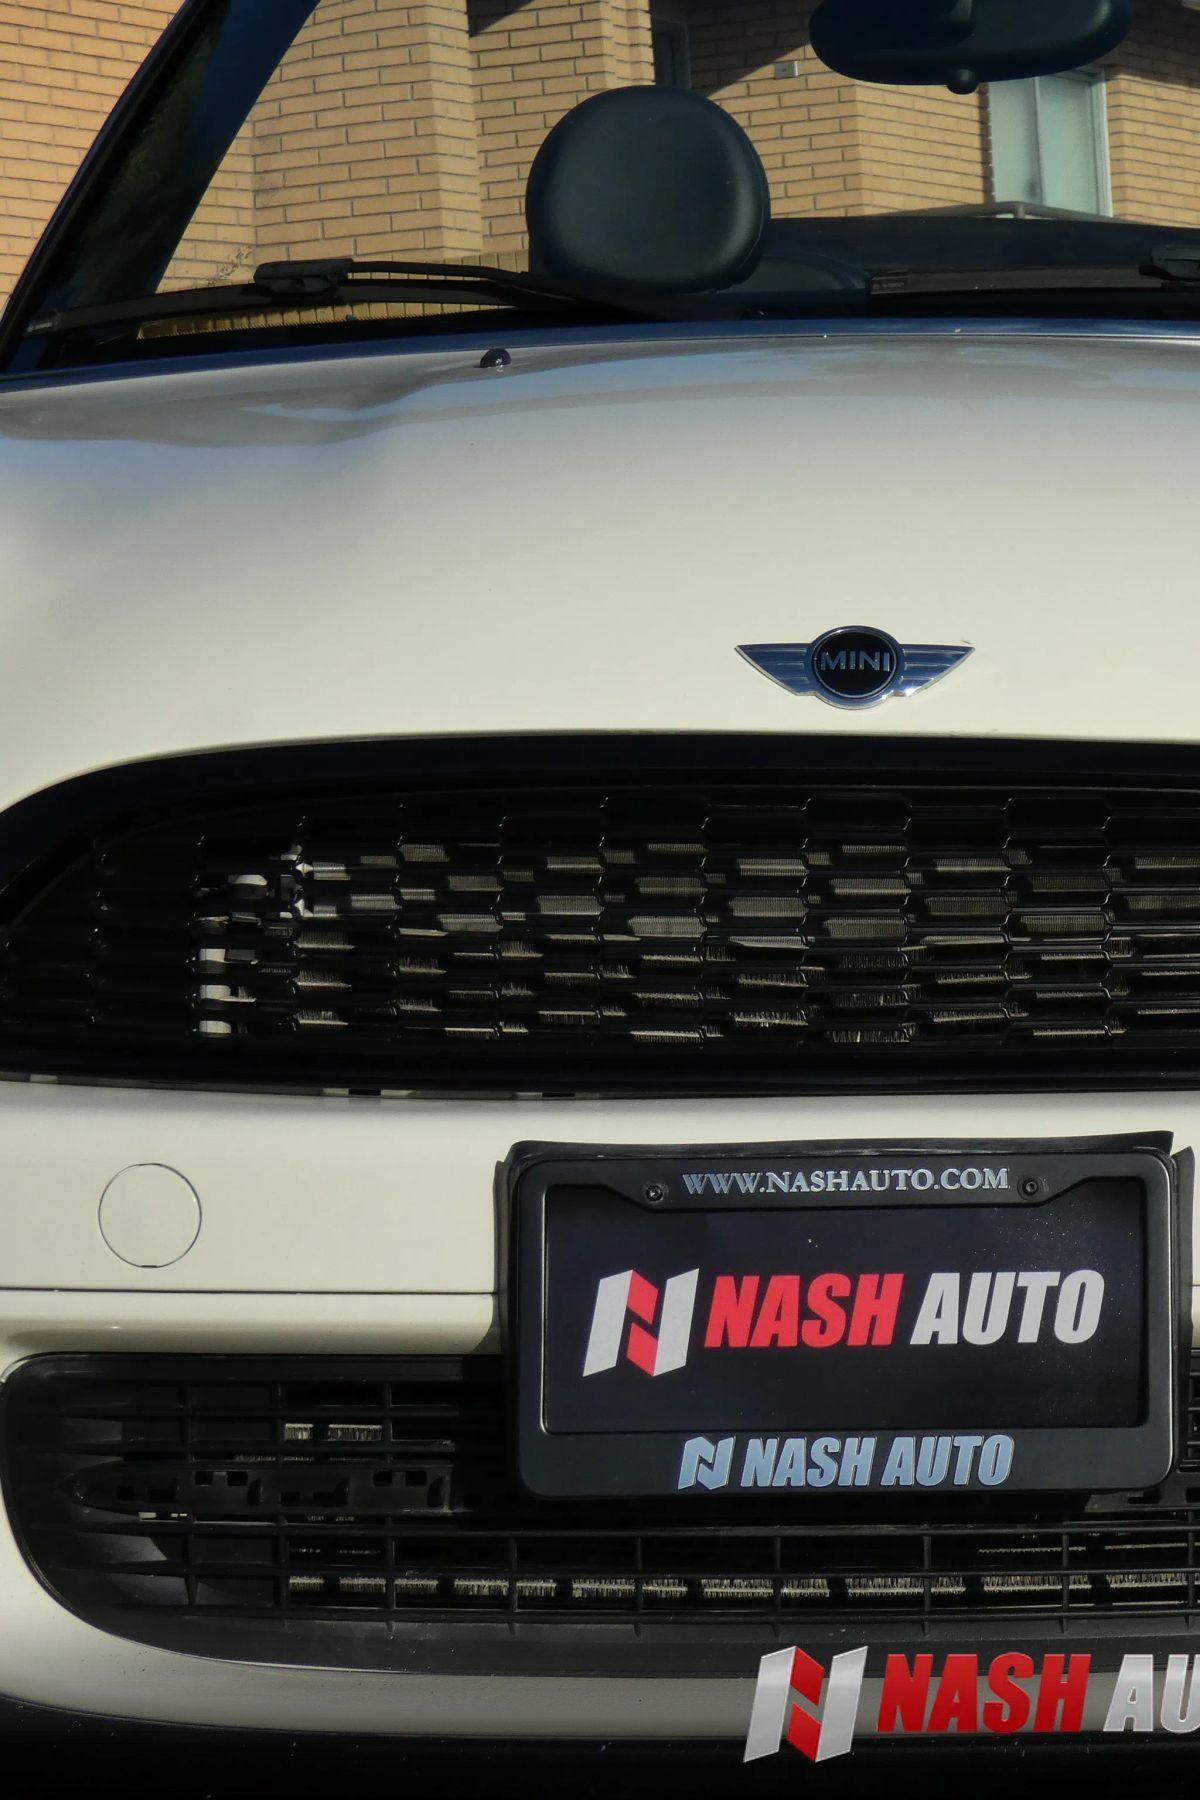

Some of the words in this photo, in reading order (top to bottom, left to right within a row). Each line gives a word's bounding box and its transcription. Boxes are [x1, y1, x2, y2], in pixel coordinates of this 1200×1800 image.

[820, 651, 890, 672] MINI
[682, 1168, 1009, 1195] WWW.NASHAUTO.COM
[704, 1273, 903, 1348] NASH
[910, 1270, 1105, 1345] AUTO
[740, 1437, 878, 1487] NASH
[881, 1435, 1014, 1486] AUTO
